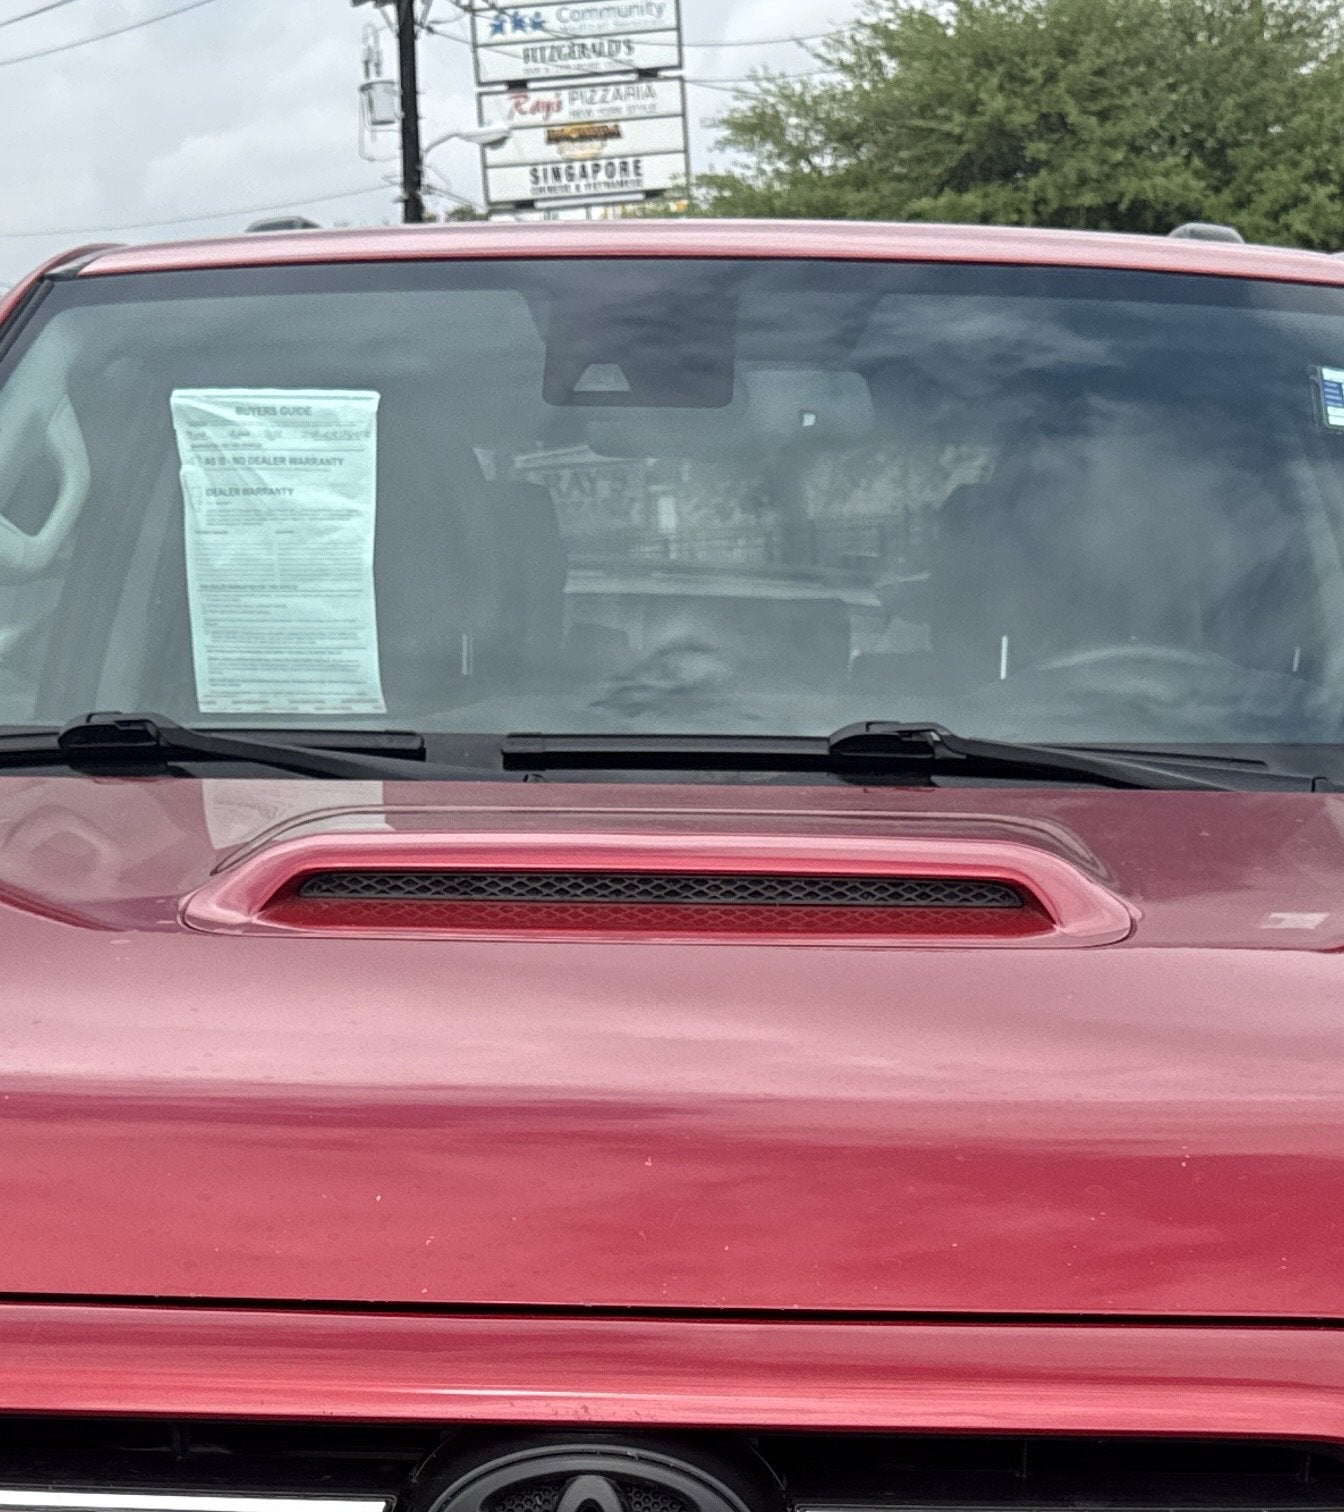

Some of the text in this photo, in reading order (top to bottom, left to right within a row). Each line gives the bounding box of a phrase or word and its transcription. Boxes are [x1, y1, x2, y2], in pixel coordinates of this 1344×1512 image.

[555, 1, 666, 24] Community
[529, 159, 644, 185] SINGAPORE
[235, 406, 313, 417] BUYERS GUIDE
[248, 456, 287, 466] DEALER
[289, 457, 344, 467] WARRANTY
[206, 487, 295, 497] DEALER WARRANTY
